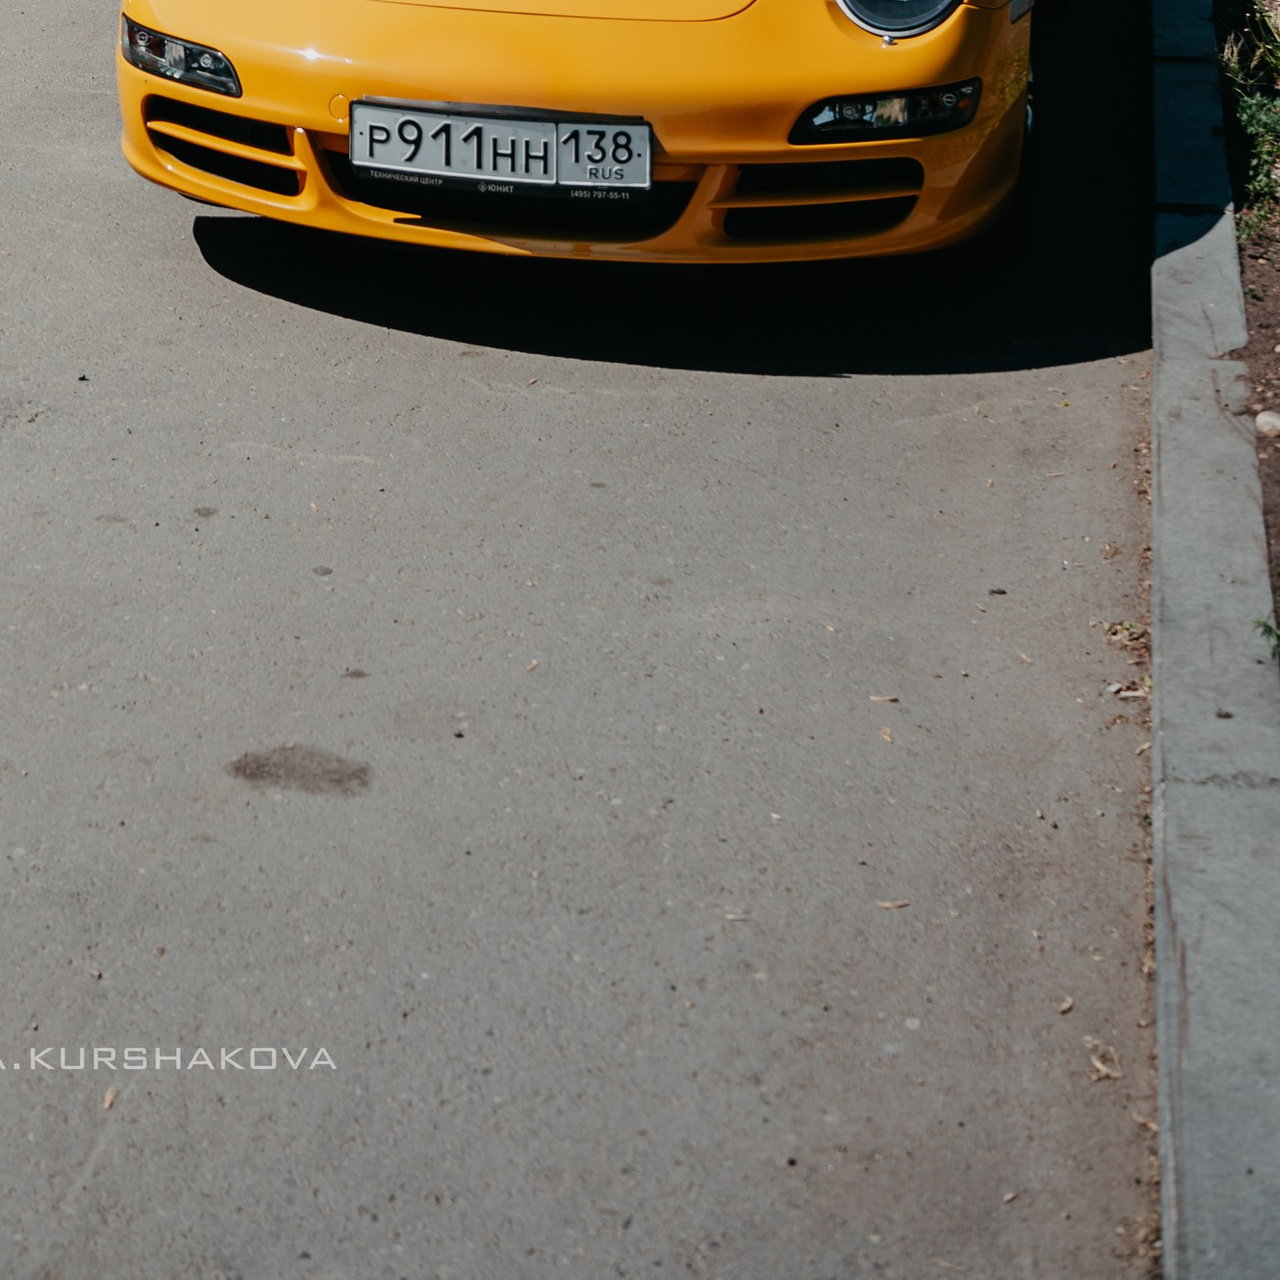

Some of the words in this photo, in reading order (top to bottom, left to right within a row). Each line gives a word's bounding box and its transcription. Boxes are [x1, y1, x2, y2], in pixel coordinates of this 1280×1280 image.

[369, 117, 548, 175] Р911НН
[561, 130, 634, 164] 138
[370, 170, 419, 183] ТЕХНИЧЕСКИЙ
[420, 176, 443, 185] ЦЕНТР
[587, 167, 625, 180] RUS
[488, 184, 514, 193] ЮНИТ
[571, 189, 591, 198] (495)
[593, 190, 630, 199] 797-55-11
